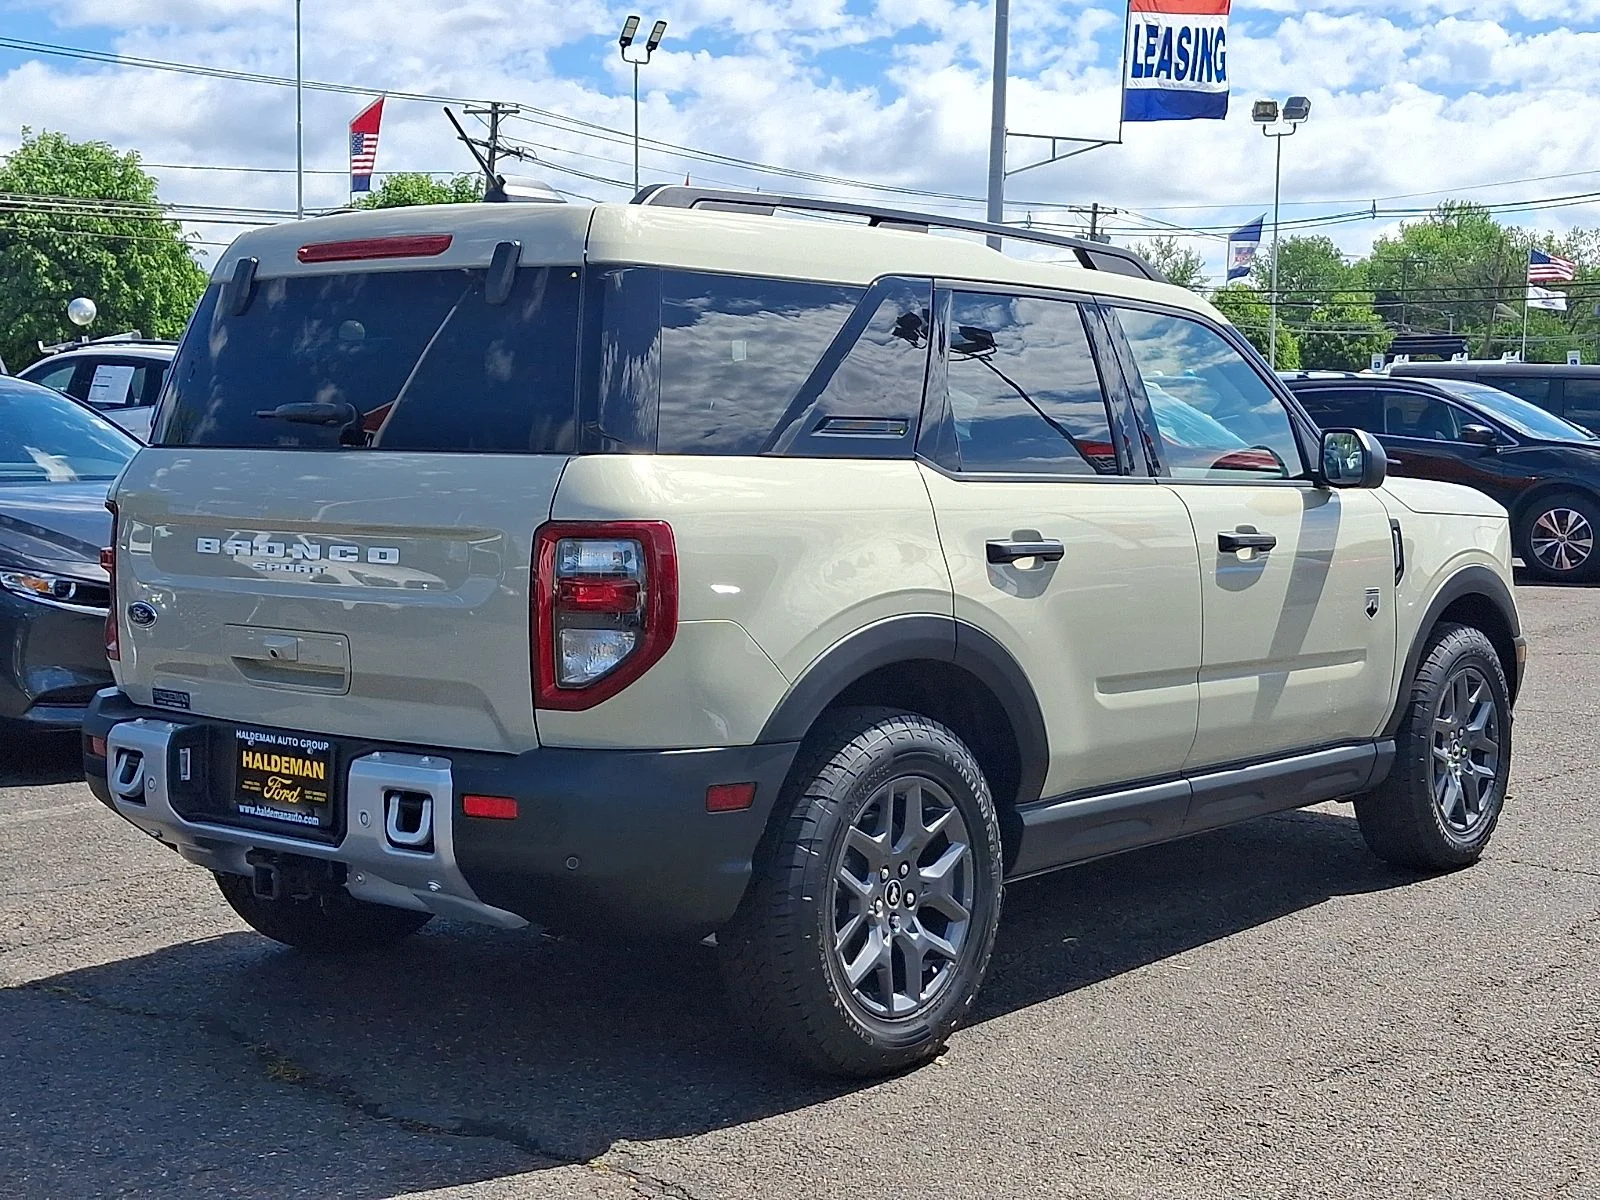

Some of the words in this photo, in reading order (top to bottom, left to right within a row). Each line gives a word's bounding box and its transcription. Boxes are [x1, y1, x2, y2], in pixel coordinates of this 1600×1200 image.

[1131, 24, 1226, 83] LEASING
[197, 537, 400, 564] BRONCO
[252, 562, 328, 574] SPORT
[236, 729, 276, 744] HALDEMAN
[277, 736, 298, 746] AUTO
[300, 739, 329, 750] GROUP
[242, 750, 325, 780] HALDEMAN
[263, 775, 302, 803] Ford
[239, 805, 319, 825] www.haldemanauto.com
